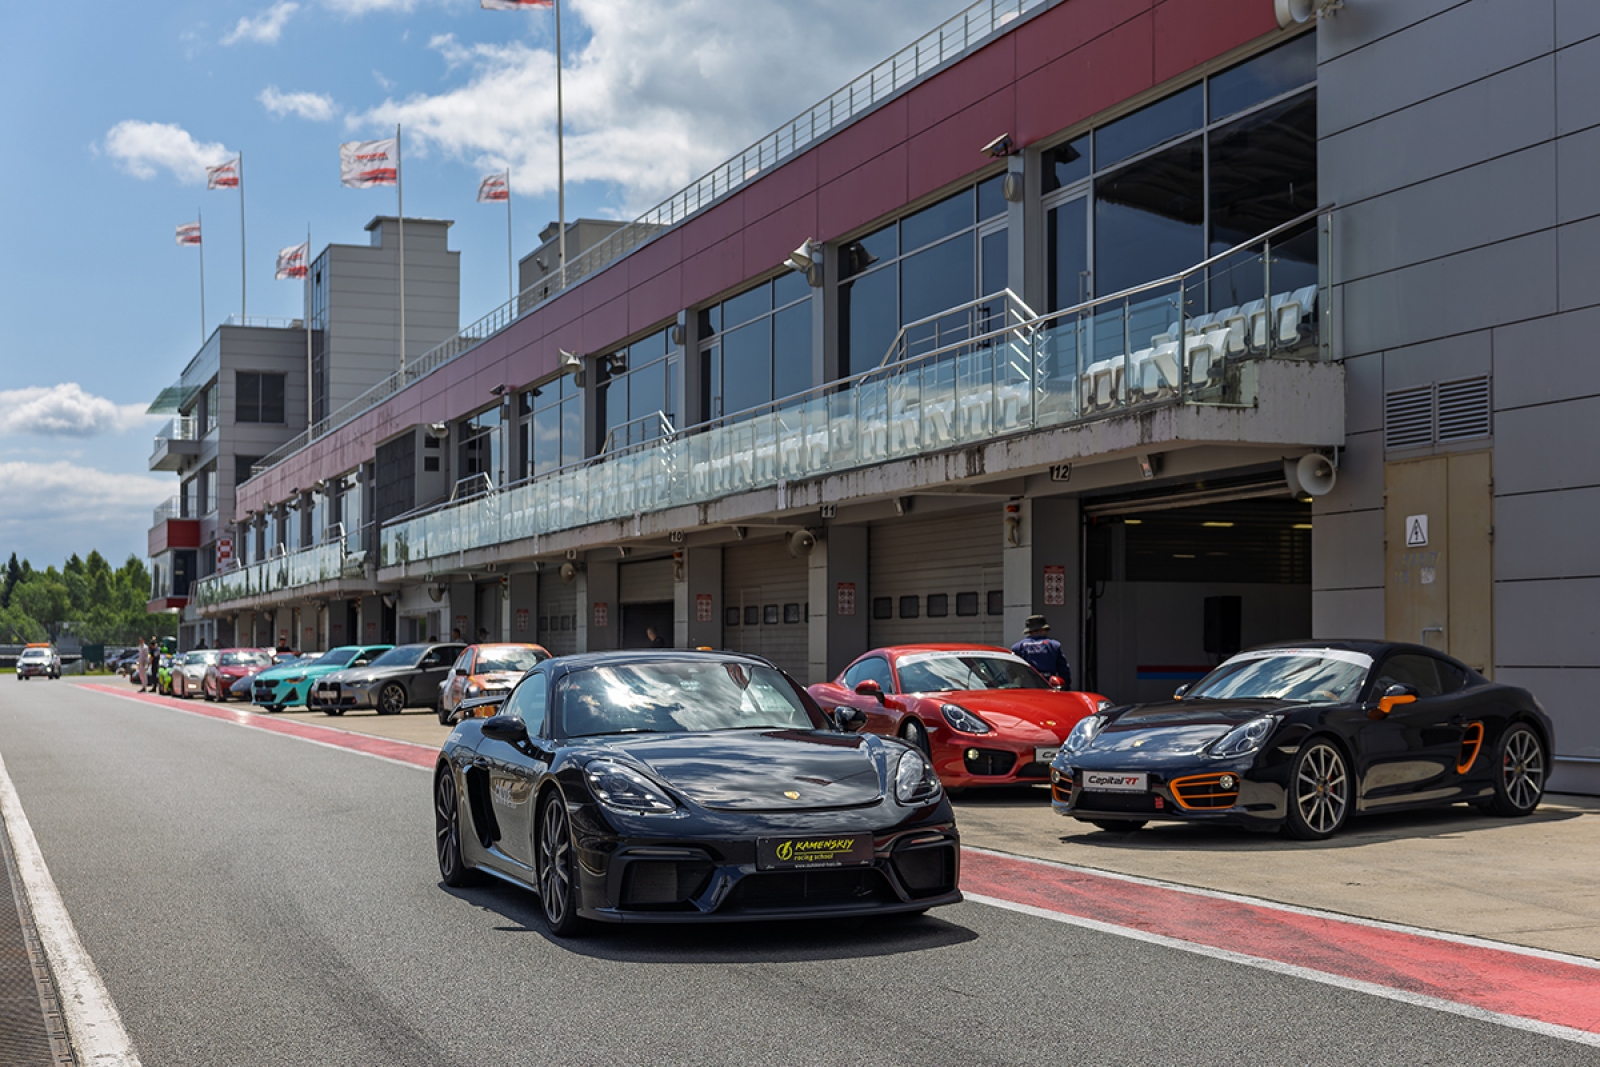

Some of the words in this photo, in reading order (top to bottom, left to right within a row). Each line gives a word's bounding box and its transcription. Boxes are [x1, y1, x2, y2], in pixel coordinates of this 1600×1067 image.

[1055, 464, 1069, 479] 12
[823, 504, 834, 516] 11
[672, 531, 682, 541] 10
[795, 838, 856, 851] KAMENSKIY
[794, 853, 813, 862] racing
[814, 852, 834, 861] school
